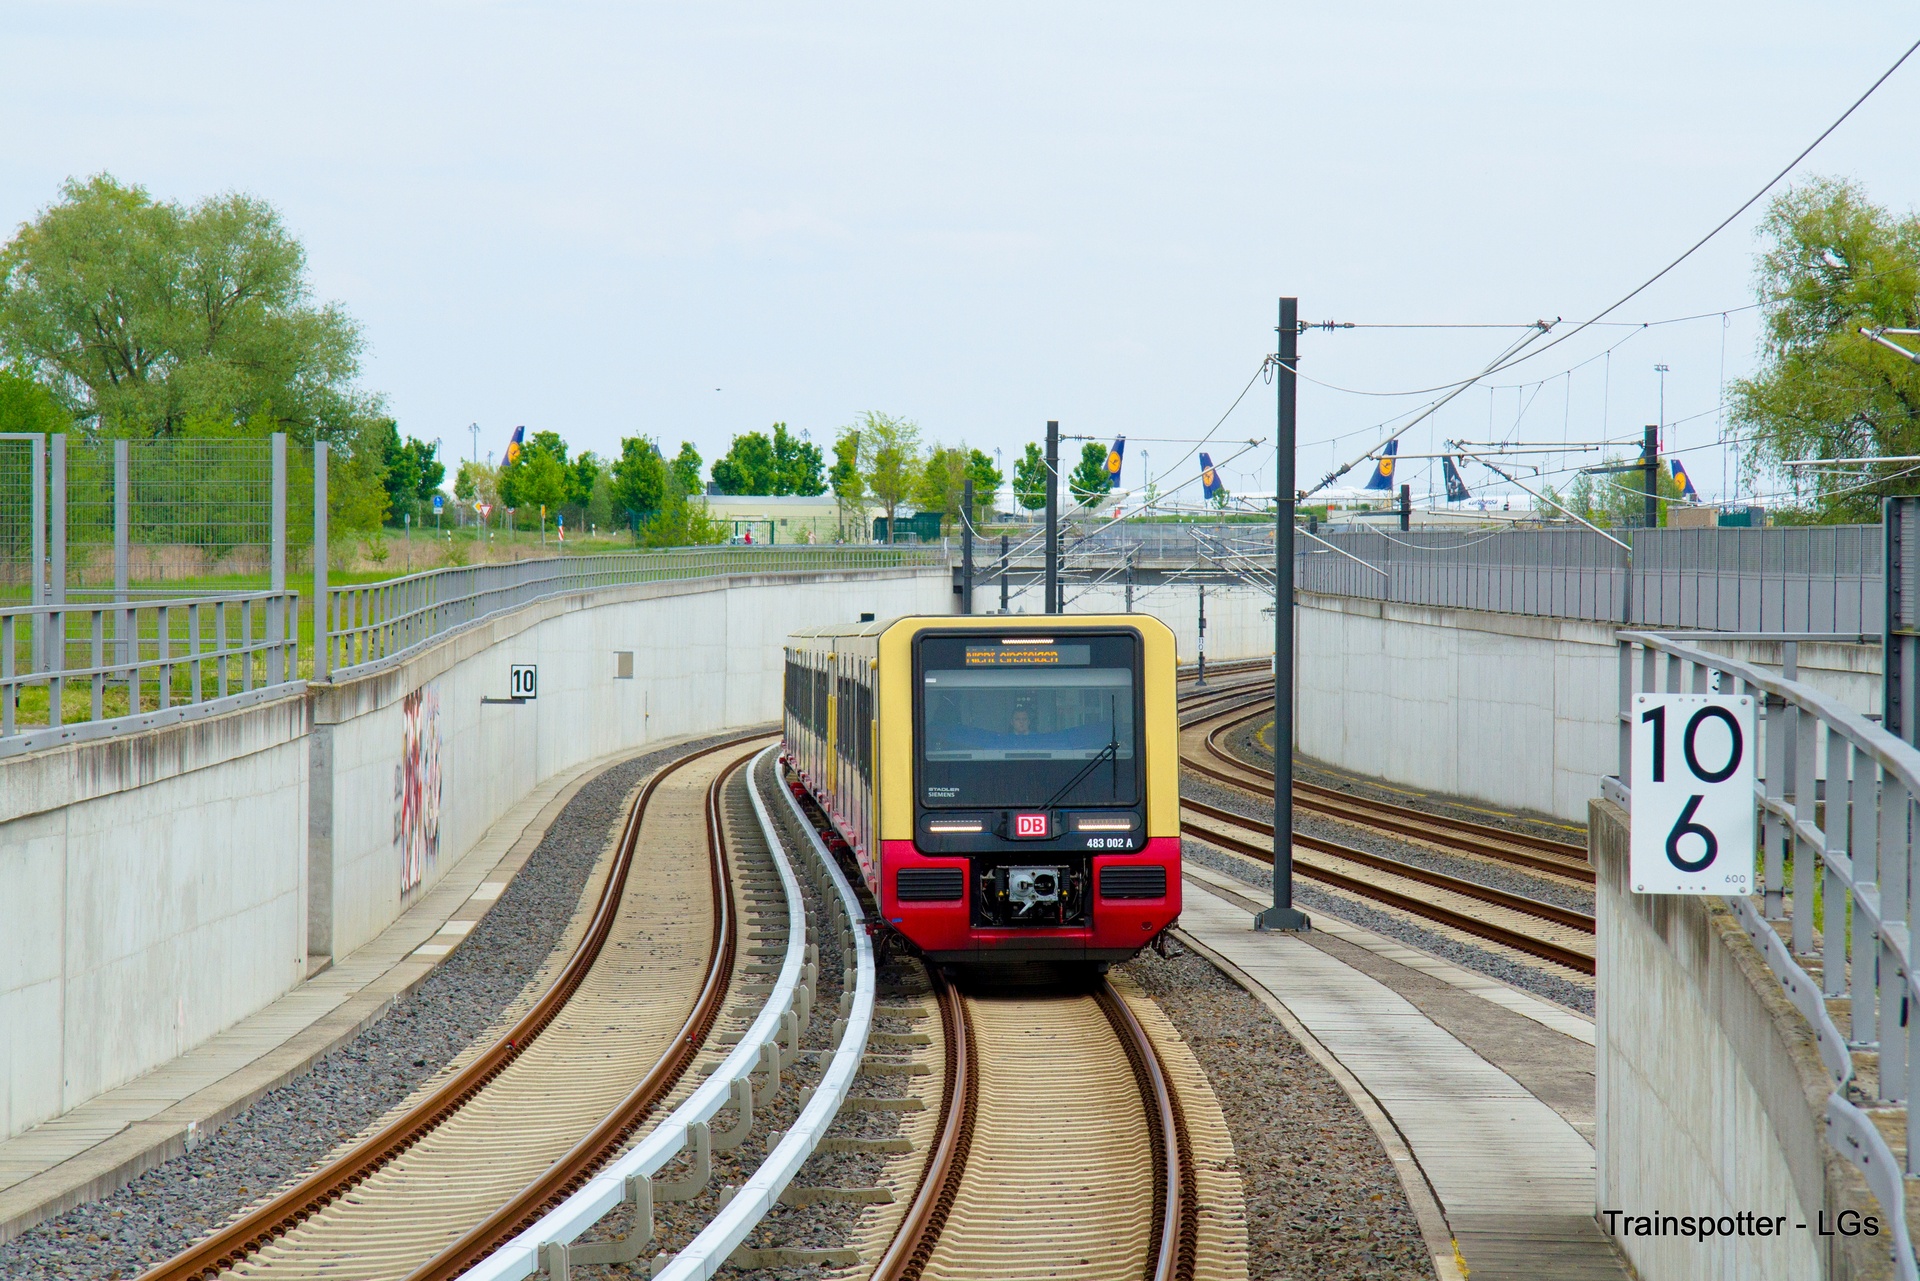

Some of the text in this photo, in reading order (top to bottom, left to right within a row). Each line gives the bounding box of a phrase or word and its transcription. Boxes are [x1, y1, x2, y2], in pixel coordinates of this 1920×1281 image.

[966, 648, 996, 664] Nicht
[513, 669, 534, 693] 10
[1642, 705, 1743, 783] 10
[1020, 818, 1043, 833] DB
[1665, 794, 1719, 873] 6
[1086, 838, 1133, 848] 483 002 A
[1725, 874, 1746, 884] 600
